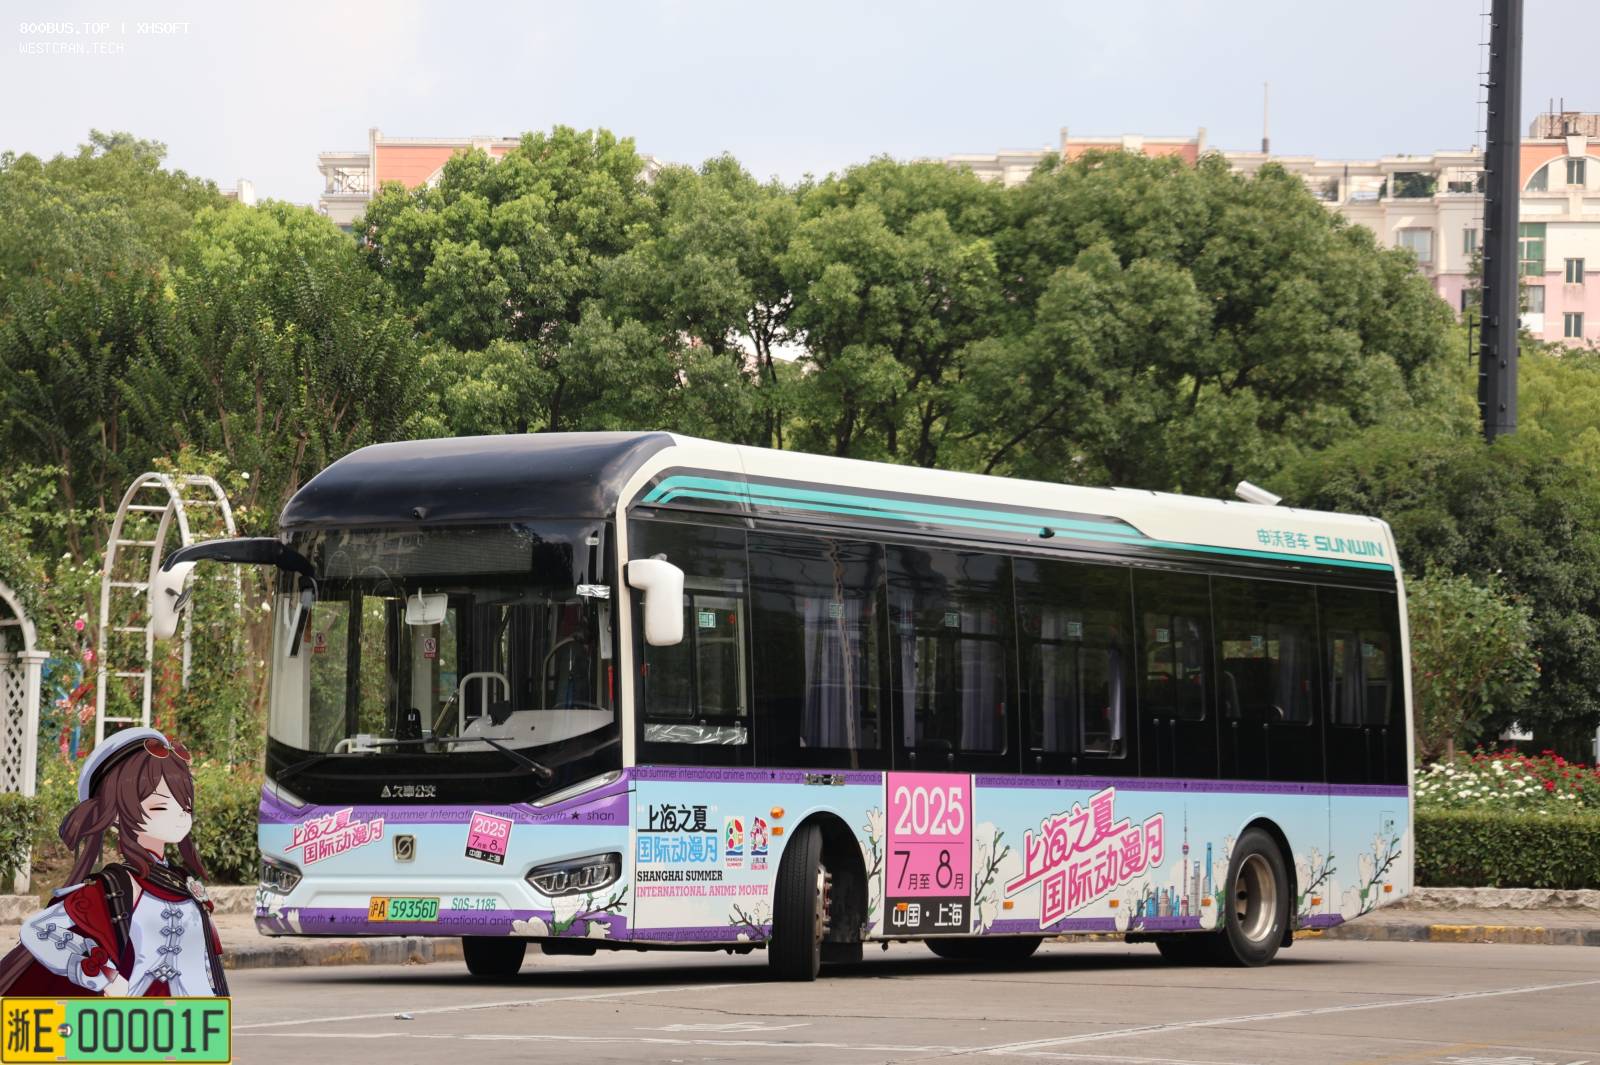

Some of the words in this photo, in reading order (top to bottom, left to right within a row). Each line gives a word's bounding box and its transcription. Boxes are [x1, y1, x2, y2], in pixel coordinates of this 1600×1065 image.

[1257, 528, 1310, 549] 申沃客车
[1314, 535, 1384, 557] SUNWIN
[637, 804, 718, 833] 上海之夏
[894, 786, 965, 836] 2025
[285, 810, 360, 852] 上海之夏
[304, 820, 383, 865] 国际动漫月
[474, 818, 506, 838] 2025
[1007, 791, 1129, 893] 上海之夏
[637, 835, 718, 863] 国际动漫月
[637, 870, 684, 882] SHANGHAI
[685, 870, 723, 881] SUMMER
[1041, 816, 1162, 925] 国际动漫月
[637, 886, 707, 897] INTERNATIONAL
[709, 885, 737, 896] ANIME
[738, 885, 769, 896] MONTH
[391, 900, 438, 918] 59356D
[492, 914, 516, 926] anim
